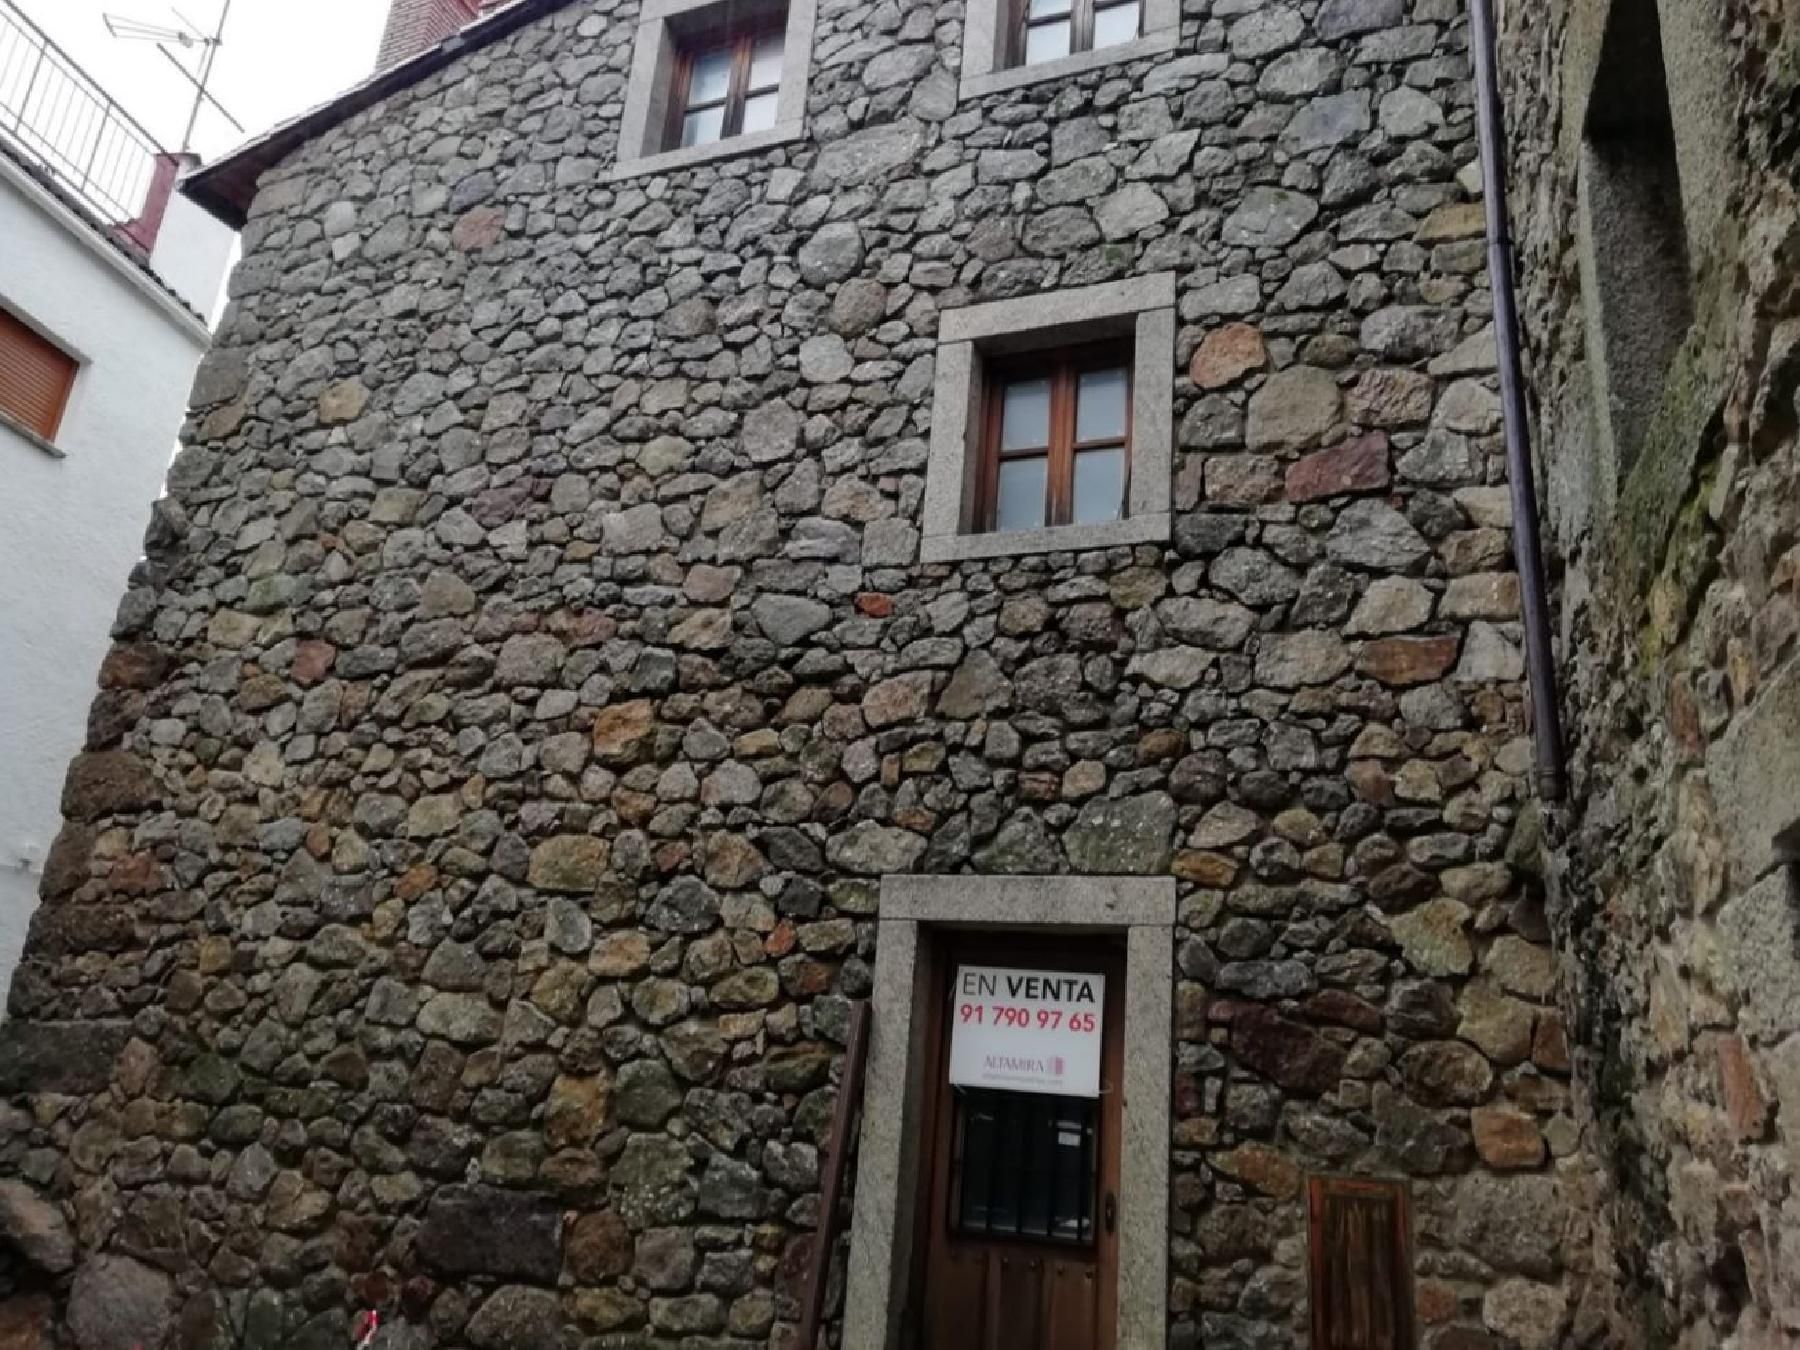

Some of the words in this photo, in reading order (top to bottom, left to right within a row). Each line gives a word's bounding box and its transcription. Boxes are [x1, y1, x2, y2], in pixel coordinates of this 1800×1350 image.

[963, 973, 996, 996] EN
[1006, 976, 1095, 1003] VENTA
[960, 1003, 983, 1023] 91
[992, 1005, 1030, 1027] 790
[1037, 1008, 1063, 1029] 97
[1069, 1012, 1095, 1032] 65
[984, 1055, 1044, 1073] ALTAMIRA
